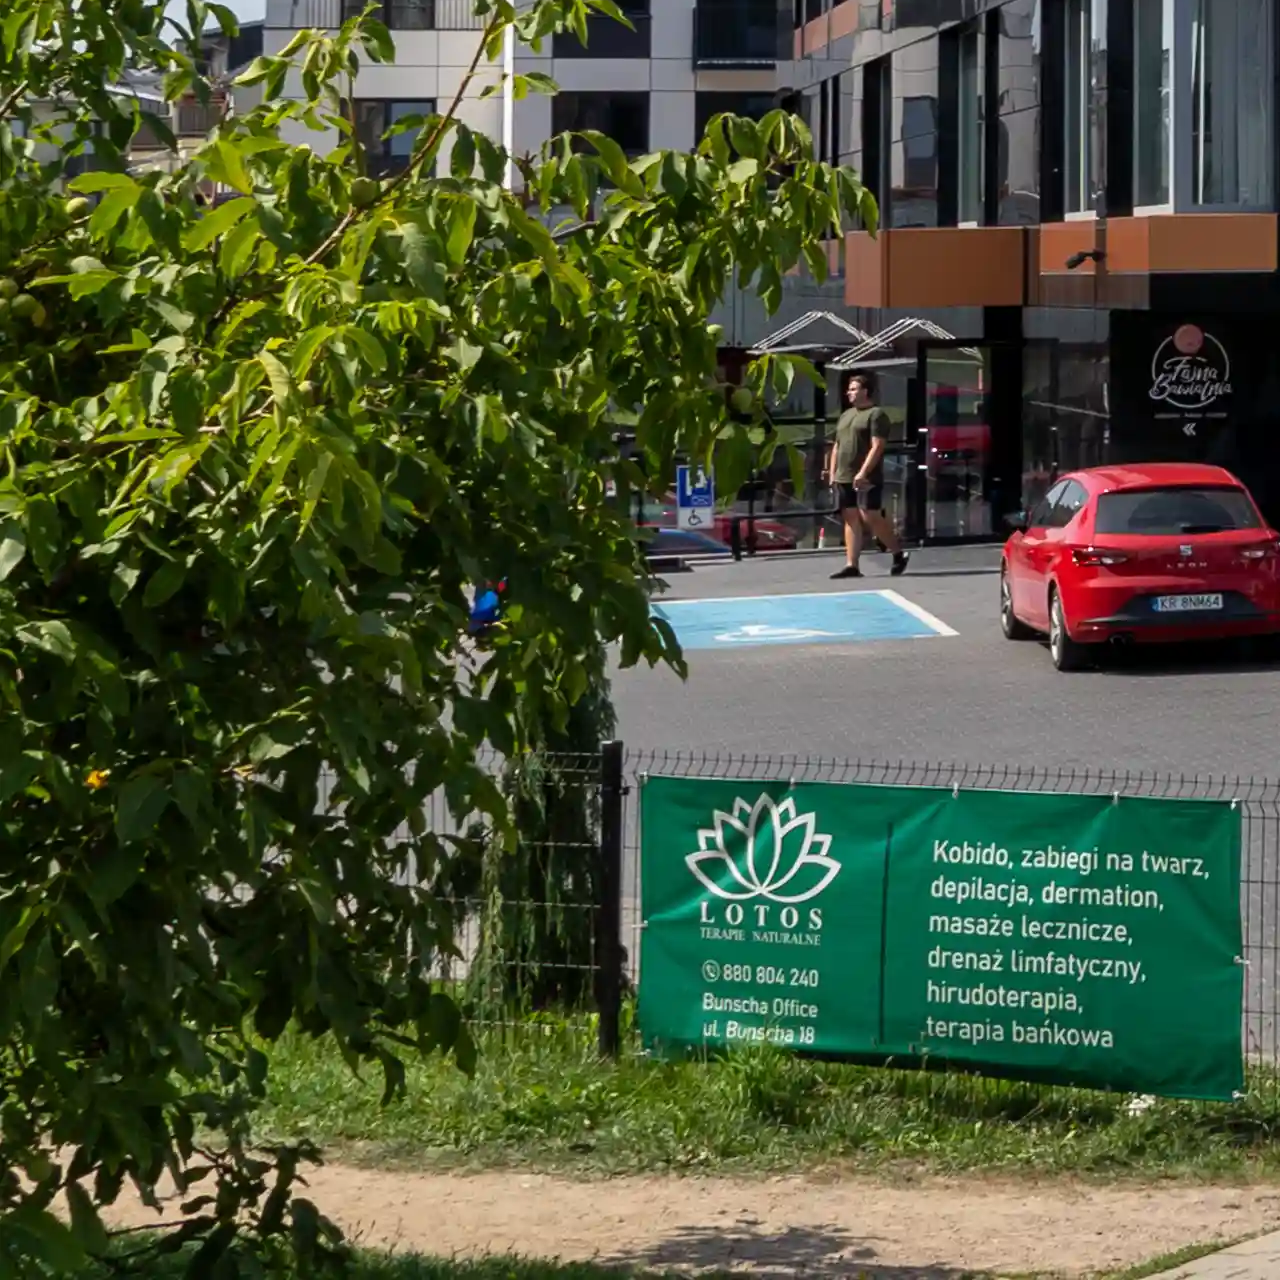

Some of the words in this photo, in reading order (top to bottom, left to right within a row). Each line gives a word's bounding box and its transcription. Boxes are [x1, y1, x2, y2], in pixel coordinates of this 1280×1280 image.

[1163, 356, 1218, 383] Fajna
[932, 839, 1014, 869] Kobido,
[1021, 845, 1098, 875] zabiegi
[1106, 852, 1133, 872] na
[1141, 849, 1210, 880] twarz,
[930, 876, 1034, 907] depilacja,
[1041, 880, 1164, 912] dermation,
[700, 901, 823, 930] LOTOS
[929, 914, 1014, 937] masaże
[1021, 914, 1133, 945] lecznicze,
[700, 927, 746, 941] TERAPIE
[752, 931, 821, 946] NATURALNE
[723, 963, 752, 982] 880
[756, 966, 786, 985] 804
[789, 968, 819, 987] 240
[928, 945, 1003, 971] drenaż
[1011, 949, 1147, 984] limfatyczny,
[702, 992, 769, 1015] Bunscha
[772, 997, 819, 1018] Office
[926, 980, 1084, 1014] hirudoterapia,
[703, 1019, 721, 1038] ul.
[726, 1020, 795, 1043] Bunscha
[800, 1025, 816, 1044] 18
[926, 1016, 1005, 1046] terapia
[1012, 1019, 1114, 1049] bańkowa
